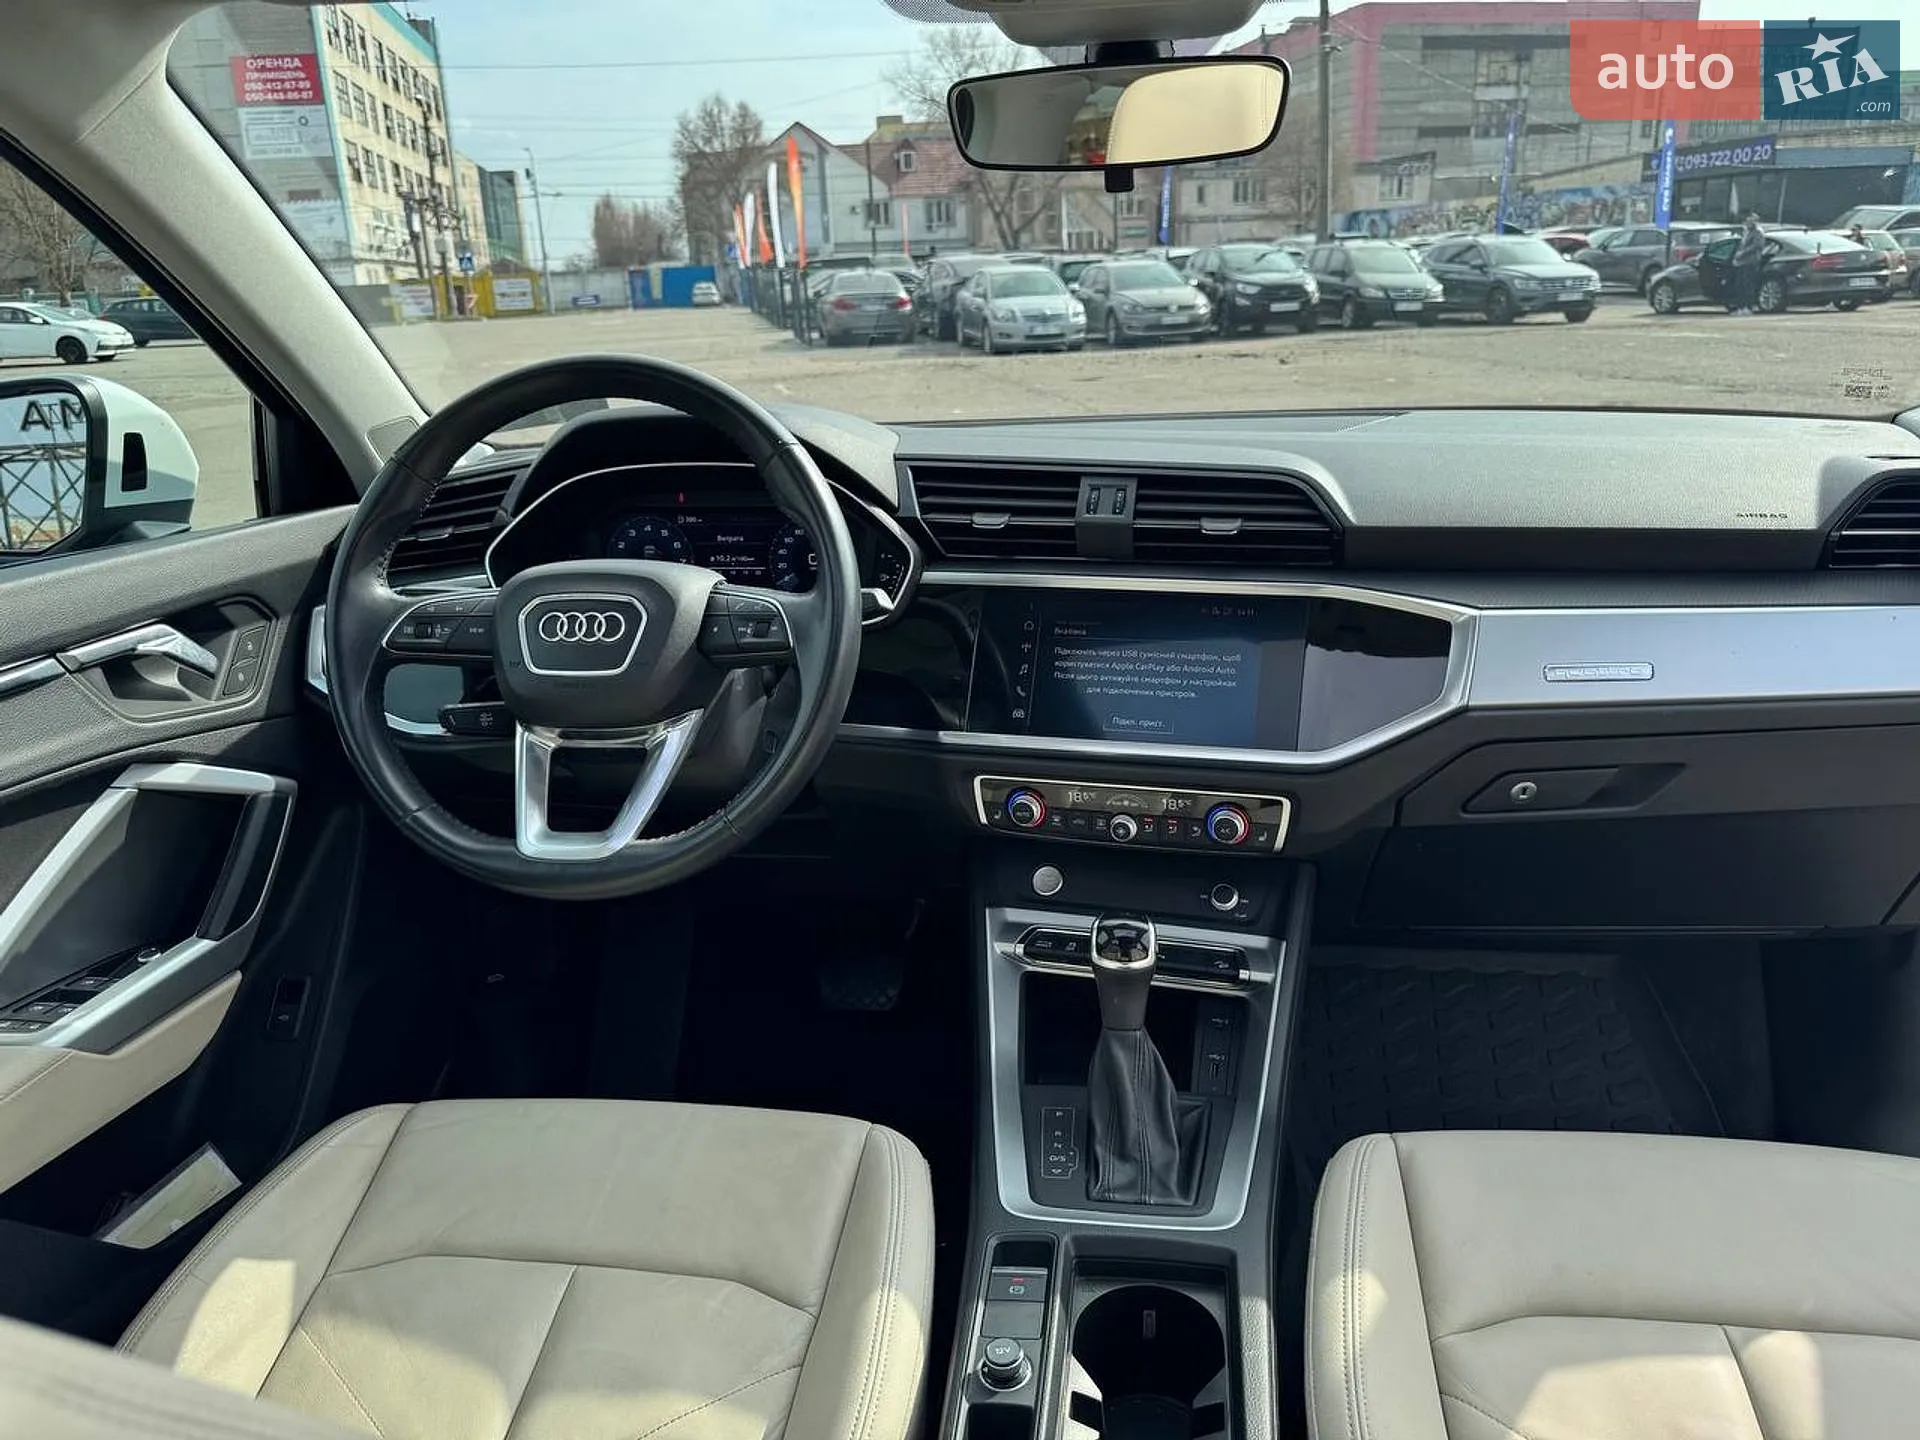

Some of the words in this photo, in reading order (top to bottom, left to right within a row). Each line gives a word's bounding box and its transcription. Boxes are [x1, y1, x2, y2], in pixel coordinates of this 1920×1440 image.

[245, 57, 302, 69] ОРЕНДА
[1685, 154, 1708, 170] 093
[1710, 150, 1731, 167] 722
[1732, 147, 1751, 165] 00
[1753, 144, 1771, 160] 20
[1122, 649, 1138, 657] USB
[1111, 662, 1134, 671] Apple
[1135, 662, 1164, 672] CarPlay
[1166, 663, 1181, 672] або
[1182, 664, 1214, 673] Android
